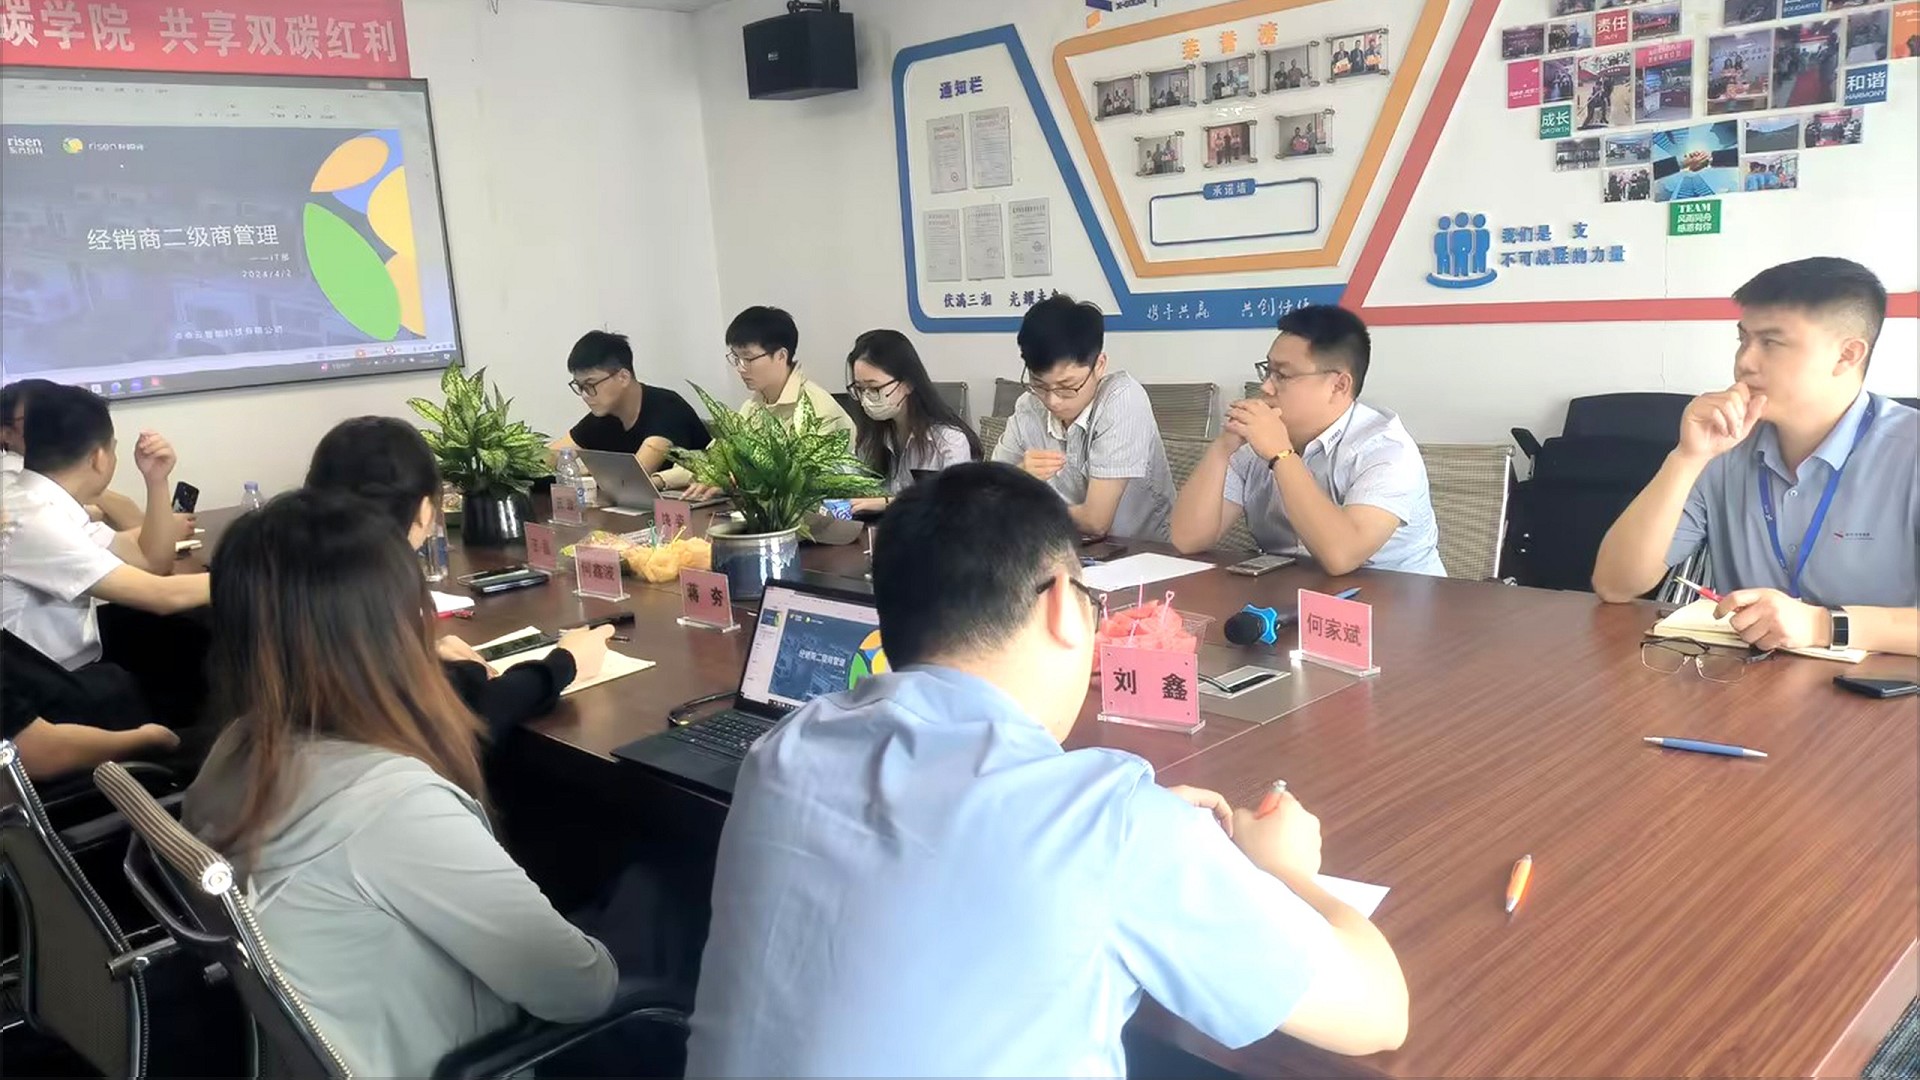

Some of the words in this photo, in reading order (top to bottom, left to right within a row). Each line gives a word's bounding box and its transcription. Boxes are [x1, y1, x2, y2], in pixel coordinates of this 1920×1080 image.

[1597, 16, 1627, 34] 责任
[159, 8, 397, 62] 共享双碳红利
[939, 76, 983, 99] 通知栏
[1847, 71, 1886, 91] 和谐
[1845, 89, 1886, 100] HARMONY
[1541, 110, 1570, 126] 成长
[1541, 126, 1570, 135] GROWTH
[7, 136, 41, 147] risen
[1678, 203, 1711, 213] TEAM
[87, 225, 280, 250] 经销商二级商管理
[1501, 246, 1626, 268] 不可战胜的力量
[1306, 613, 1362, 647] 何家斌
